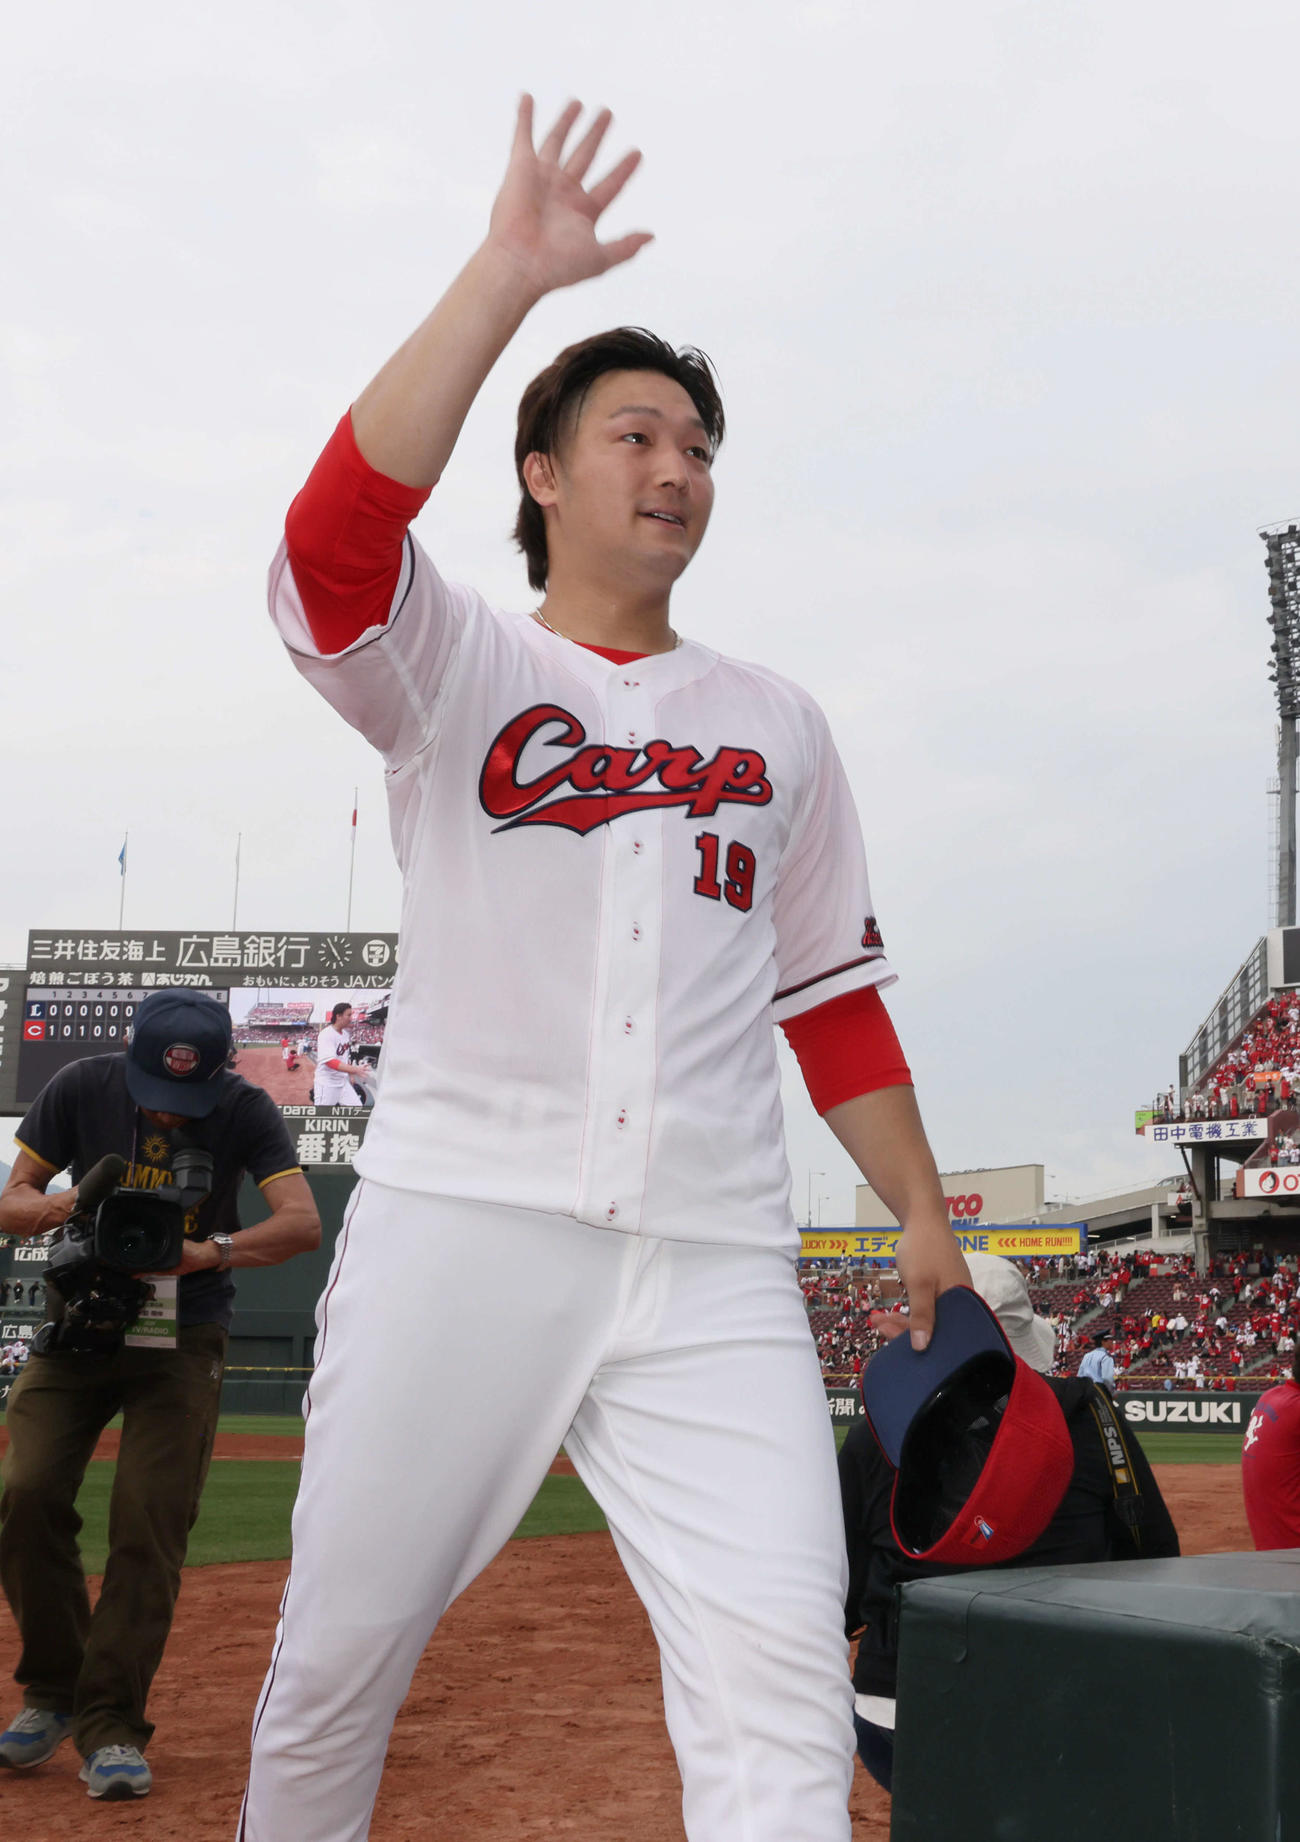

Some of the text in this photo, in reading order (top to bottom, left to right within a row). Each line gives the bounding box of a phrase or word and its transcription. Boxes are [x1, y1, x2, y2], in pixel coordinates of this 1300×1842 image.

[478, 702, 773, 836] Carp
[693, 831, 756, 914] 19
[31, 939, 166, 961] 三井住友海上
[176, 935, 311, 967] 広島銀行
[29, 970, 134, 986] 焙煎ごぼう茶
[156, 973, 213, 986] あじかん
[242, 975, 340, 988] おもいに、よりそう
[50, 1005, 57, 1016] 0
[64, 1005, 72, 1016] 0
[80, 1005, 88, 1016] 0
[95, 1005, 102, 1016] 0
[110, 1005, 118, 1016] 0
[126, 1005, 133, 1016] 0
[48, 1025, 54, 1036] 1
[64, 1025, 71, 1036] 0
[80, 1025, 84, 1036] 1
[94, 1025, 102, 1036] 0
[109, 1025, 117, 1036] 0
[305, 1119, 349, 1132] KIRIN
[1153, 1121, 1258, 1141] 田中電機工業
[1019, 1237, 1043, 1247] HOME
[1125, 1400, 1240, 1423] SUZUKI
[1104, 1426, 1125, 1465] NPS
